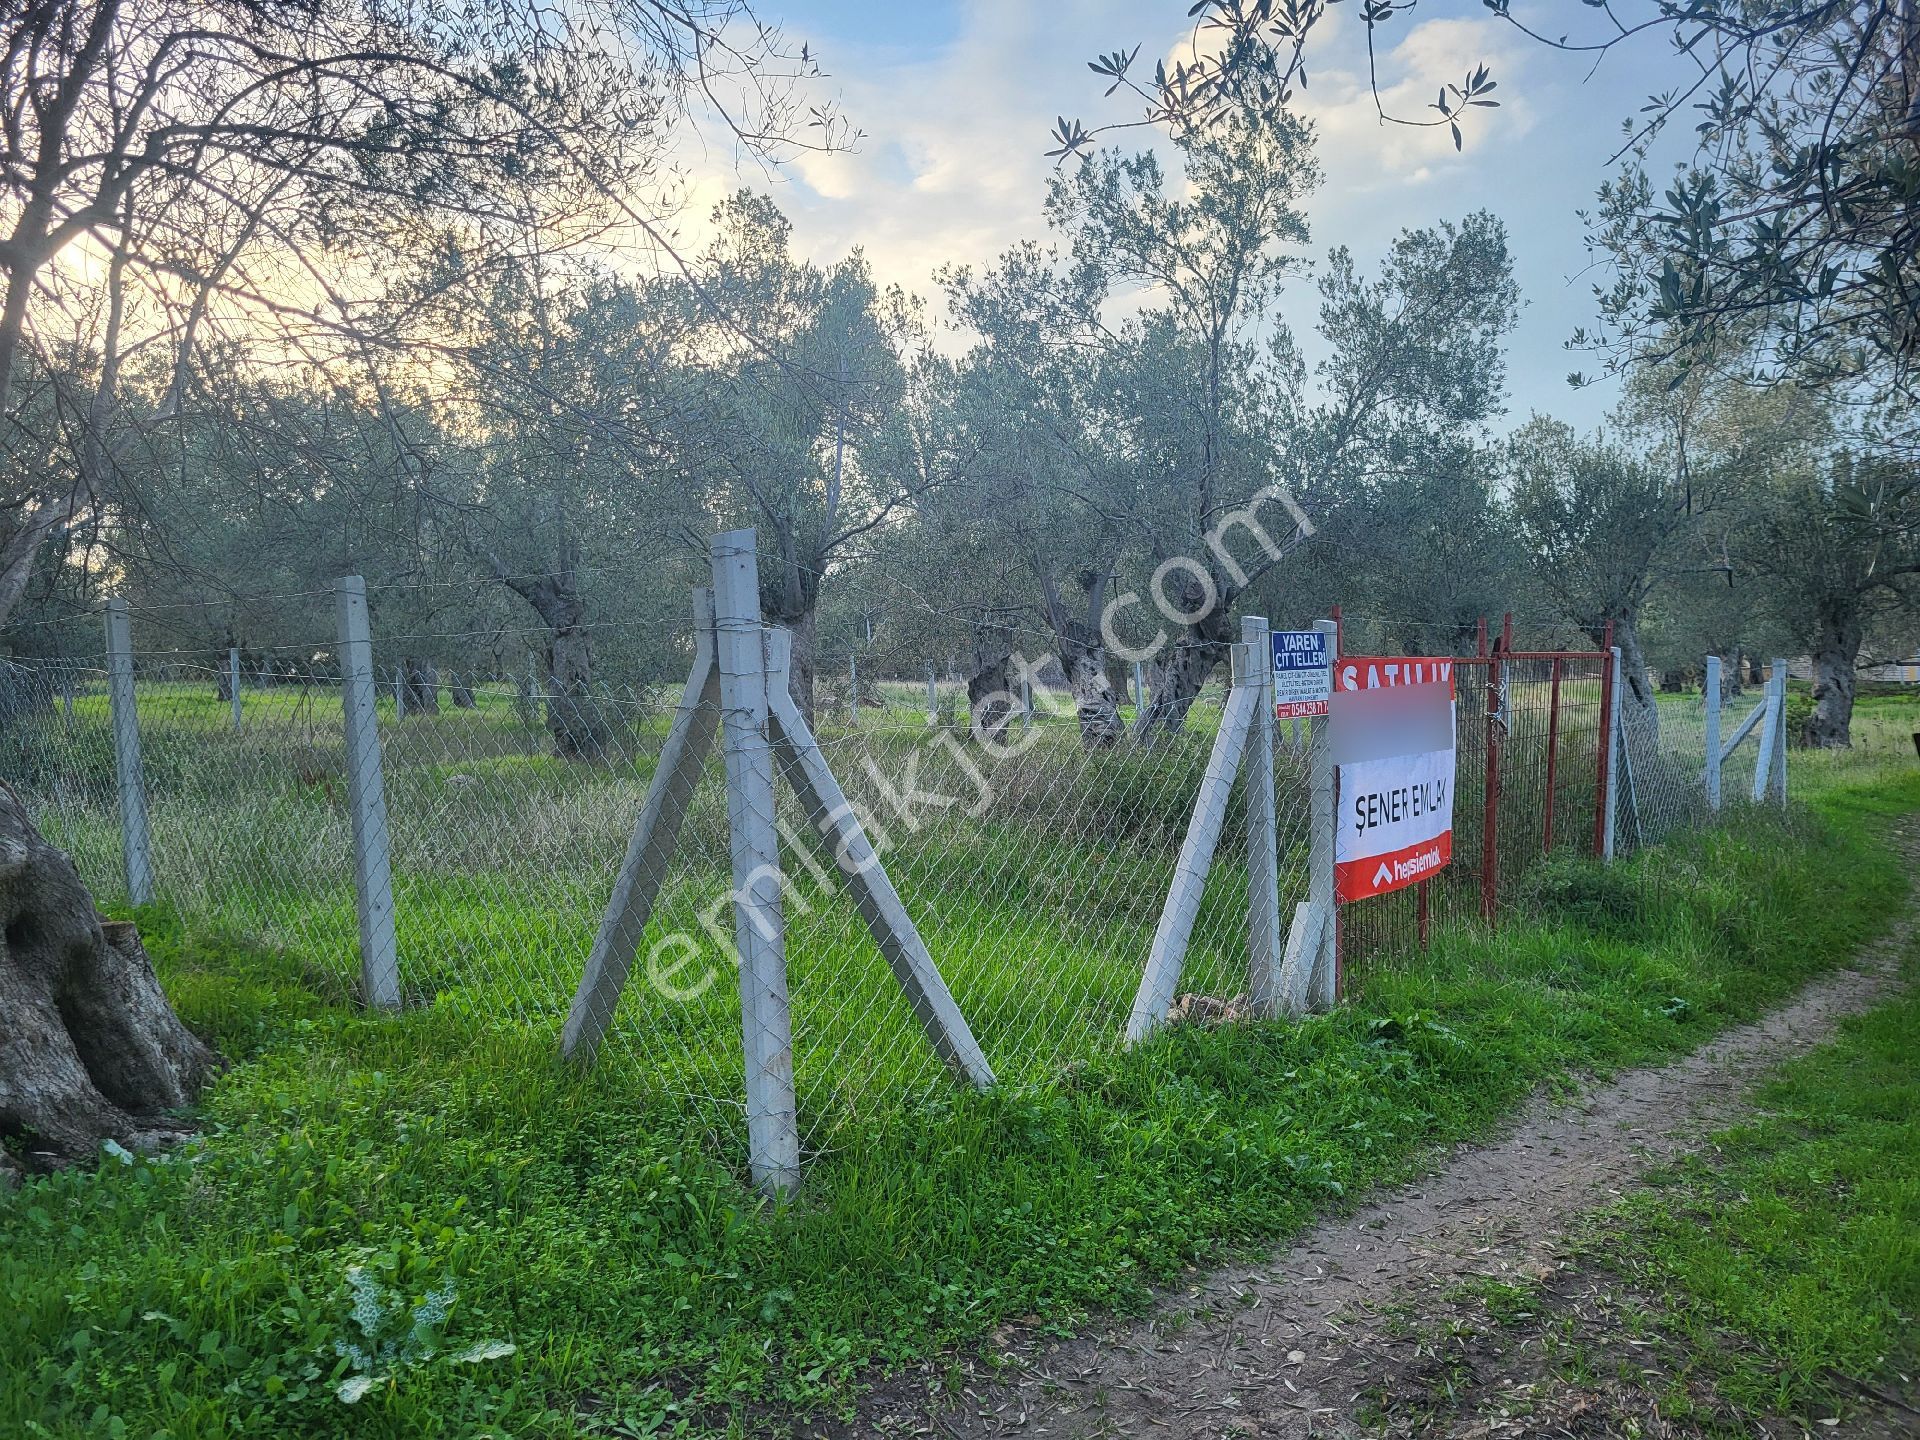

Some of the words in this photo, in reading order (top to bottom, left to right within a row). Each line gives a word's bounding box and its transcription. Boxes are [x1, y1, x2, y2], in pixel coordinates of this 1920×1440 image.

[1283, 634, 1318, 651] YAREN
[1275, 650, 1289, 669] ÇİT
[1291, 648, 1327, 667] TELLERİ
[1356, 788, 1409, 837] ŞENER
[1412, 777, 1447, 817] EMLAK
